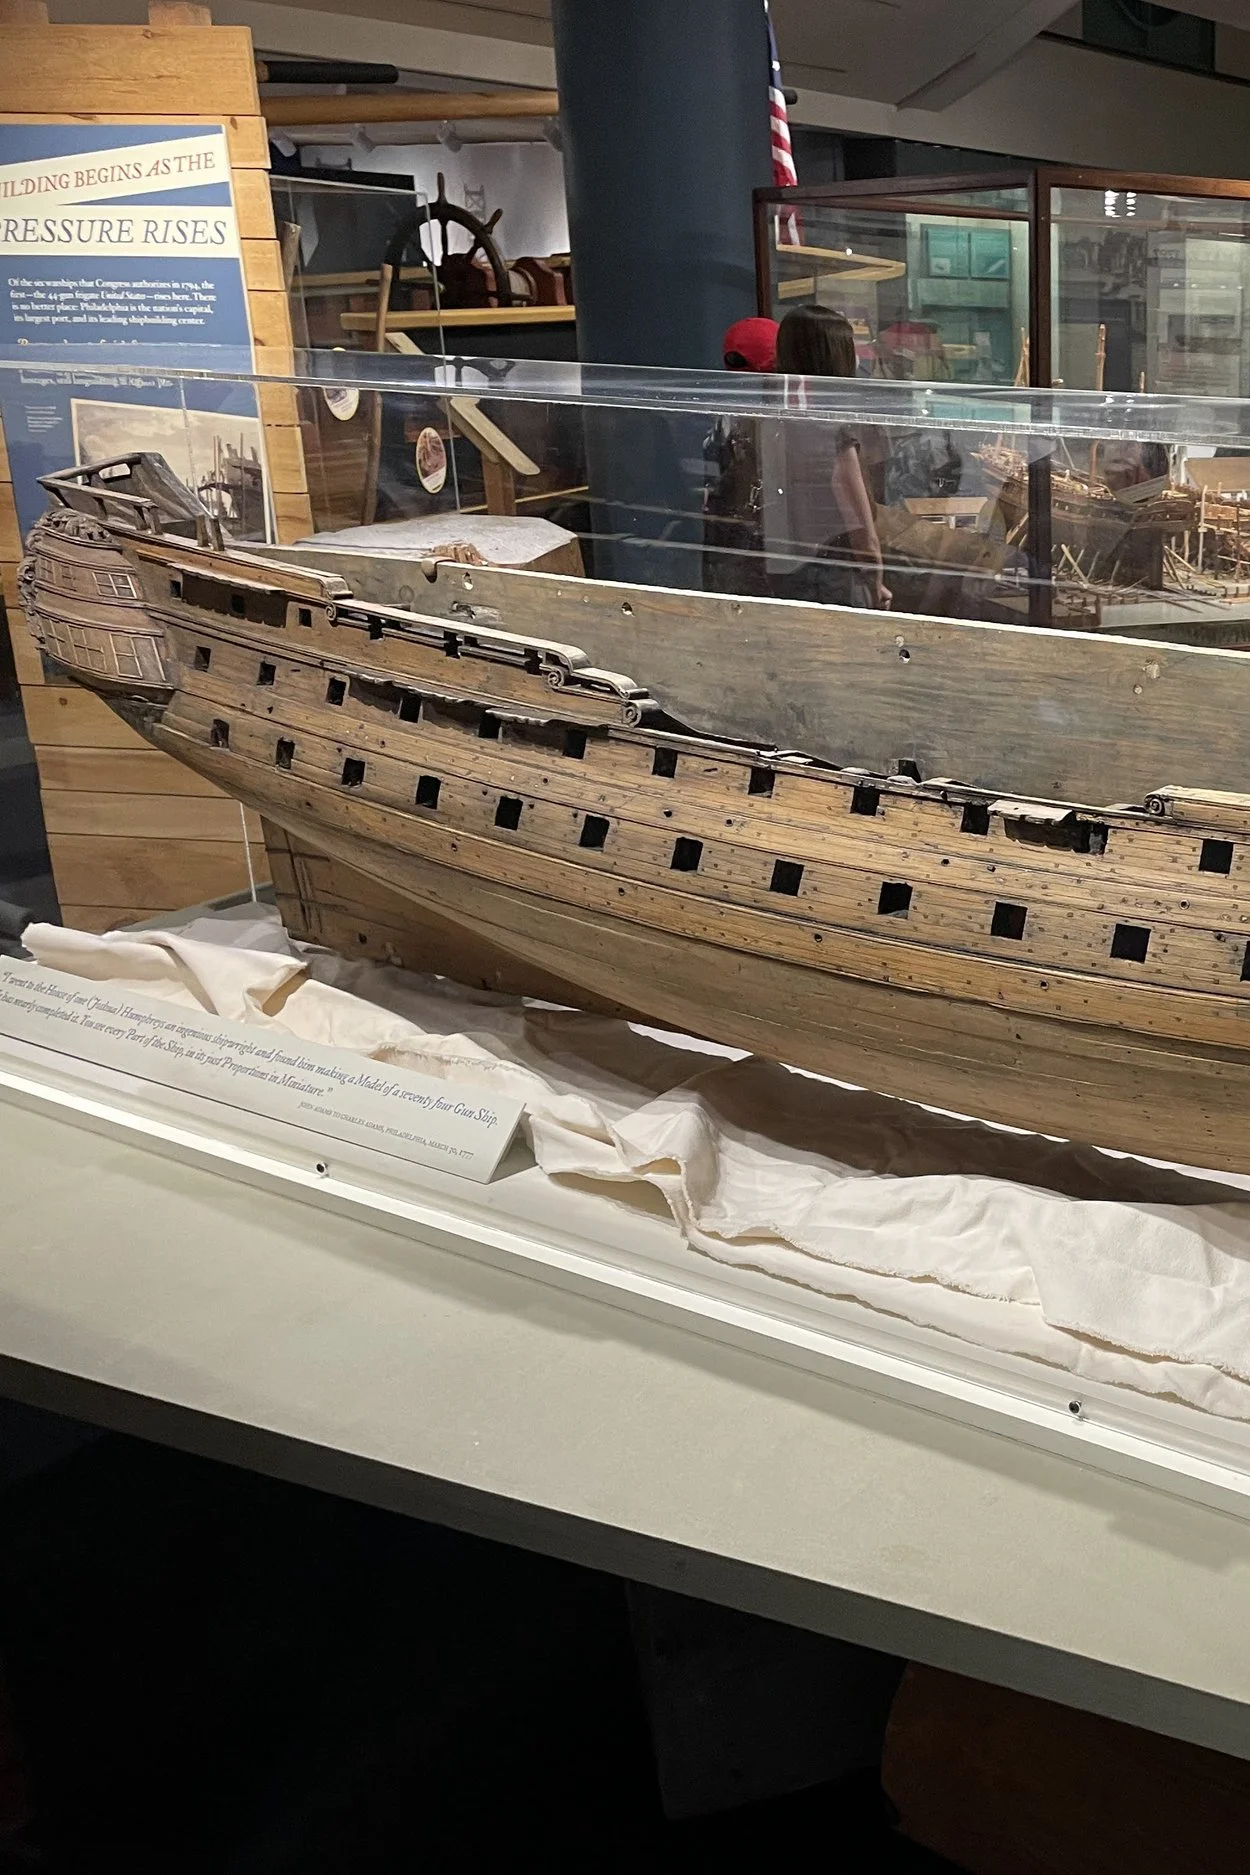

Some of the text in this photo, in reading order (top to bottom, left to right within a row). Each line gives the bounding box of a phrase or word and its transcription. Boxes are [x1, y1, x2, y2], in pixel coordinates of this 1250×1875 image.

[0, 151, 216, 198] ILDING BEGINS AS THE
[0, 218, 228, 245] RESSURE RISES
[46, 984, 66, 1000] House
[120, 1005, 165, 1030] Humphreys
[164, 1022, 175, 1031] an
[175, 1022, 212, 1043] ingenious
[210, 1033, 256, 1055] shipwright
[254, 1048, 273, 1059] and
[270, 1050, 301, 1067] found
[296, 1056, 315, 1072] him
[315, 1066, 350, 1085] making
[347, 1075, 356, 1084] a
[353, 1074, 387, 1092] Model
[382, 1083, 398, 1097] of
[392, 1088, 400, 1096] a
[398, 1090, 434, 1109] seventy
[429, 1096, 454, 1111] four
[453, 1102, 473, 1119] Gun
[473, 1107, 499, 1129] Ship.
[105, 1025, 126, 1039] every
[124, 1028, 147, 1044] Part
[144, 1034, 158, 1048] of
[163, 1039, 184, 1058] Ship,
[184, 1046, 195, 1057] in
[194, 1048, 206, 1060] its
[203, 1052, 223, 1066] just
[220, 1056, 268, 1081] Proportions
[268, 1071, 278, 1083] in
